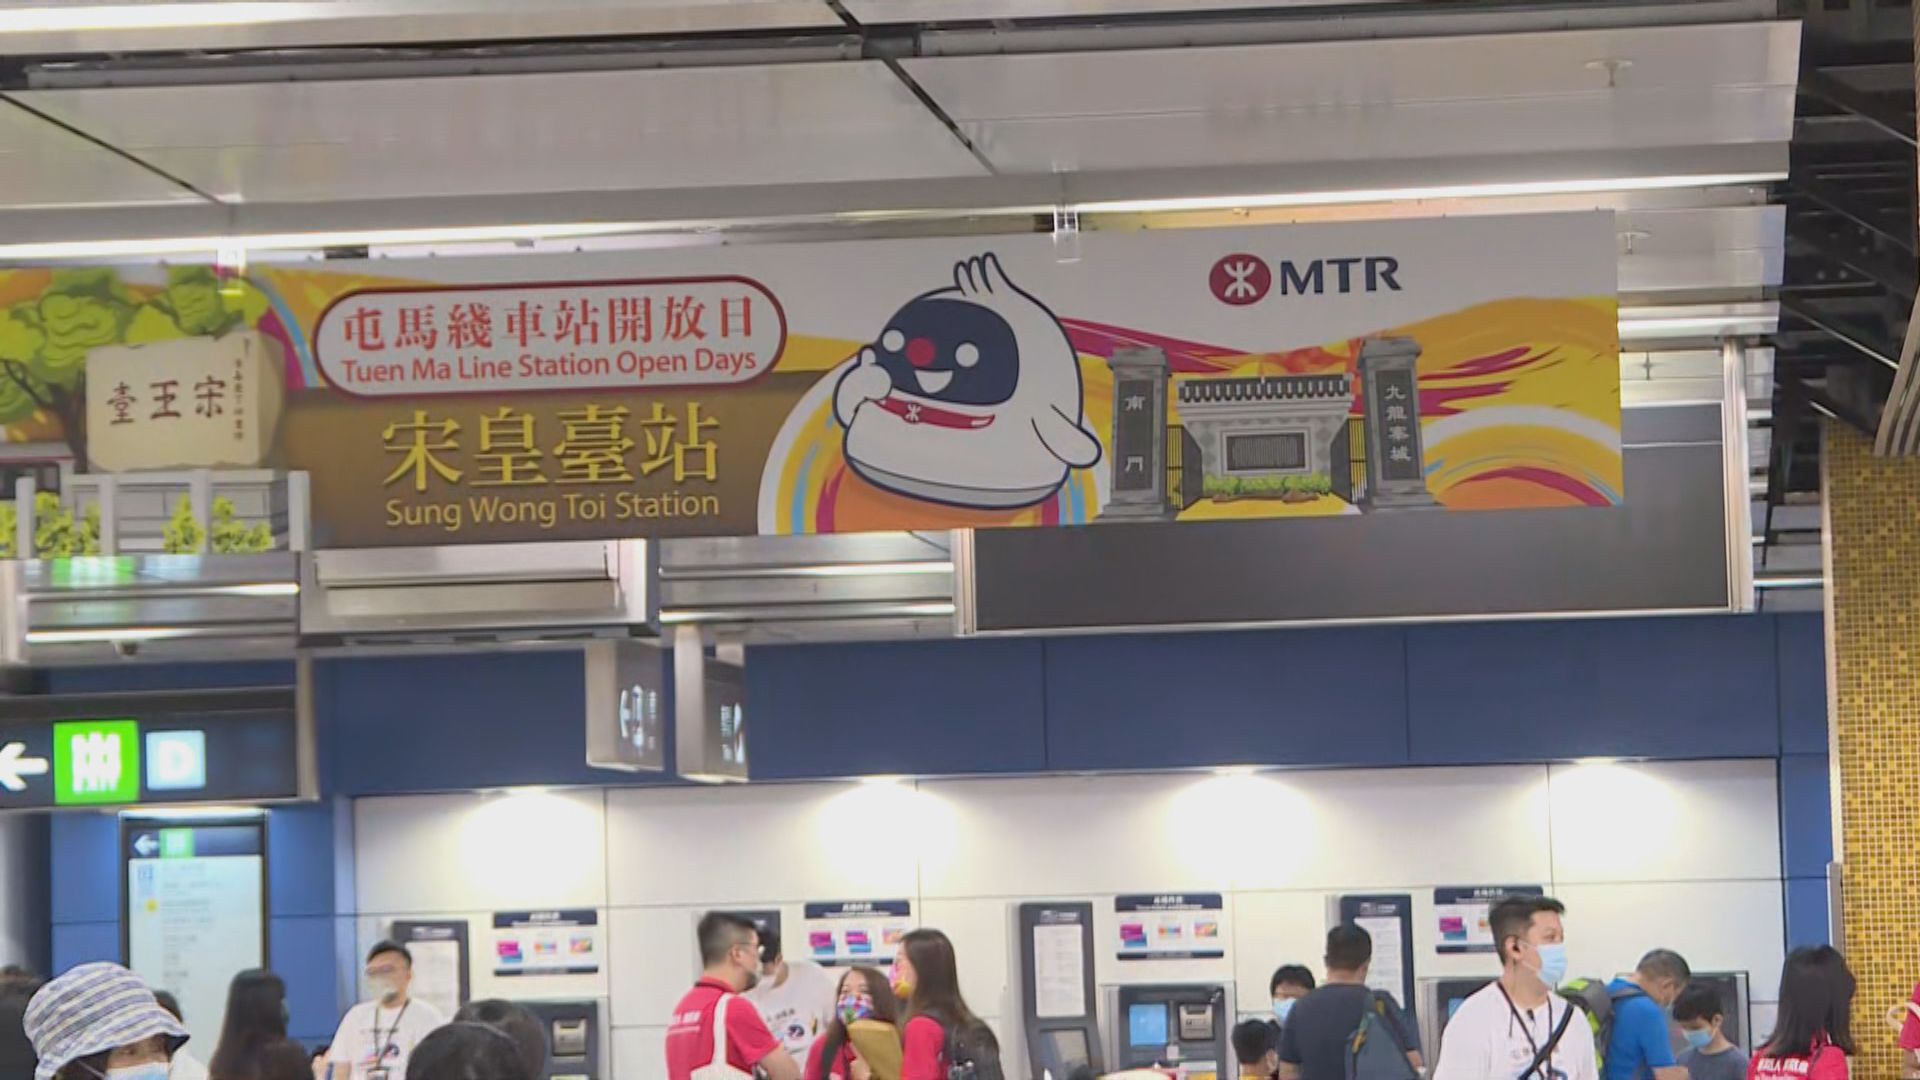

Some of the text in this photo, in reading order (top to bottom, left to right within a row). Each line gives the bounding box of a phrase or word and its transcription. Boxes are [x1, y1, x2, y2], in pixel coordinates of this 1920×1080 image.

[1280, 256, 1402, 296] MTR
[342, 295, 754, 353] 屯馬綫車站開放日
[341, 347, 757, 383] Tuen Ma Line Station Open Days
[381, 402, 721, 492] 宋皇臺站
[386, 489, 720, 531] Sung Wong Toi Station
[158, 740, 195, 780] D
